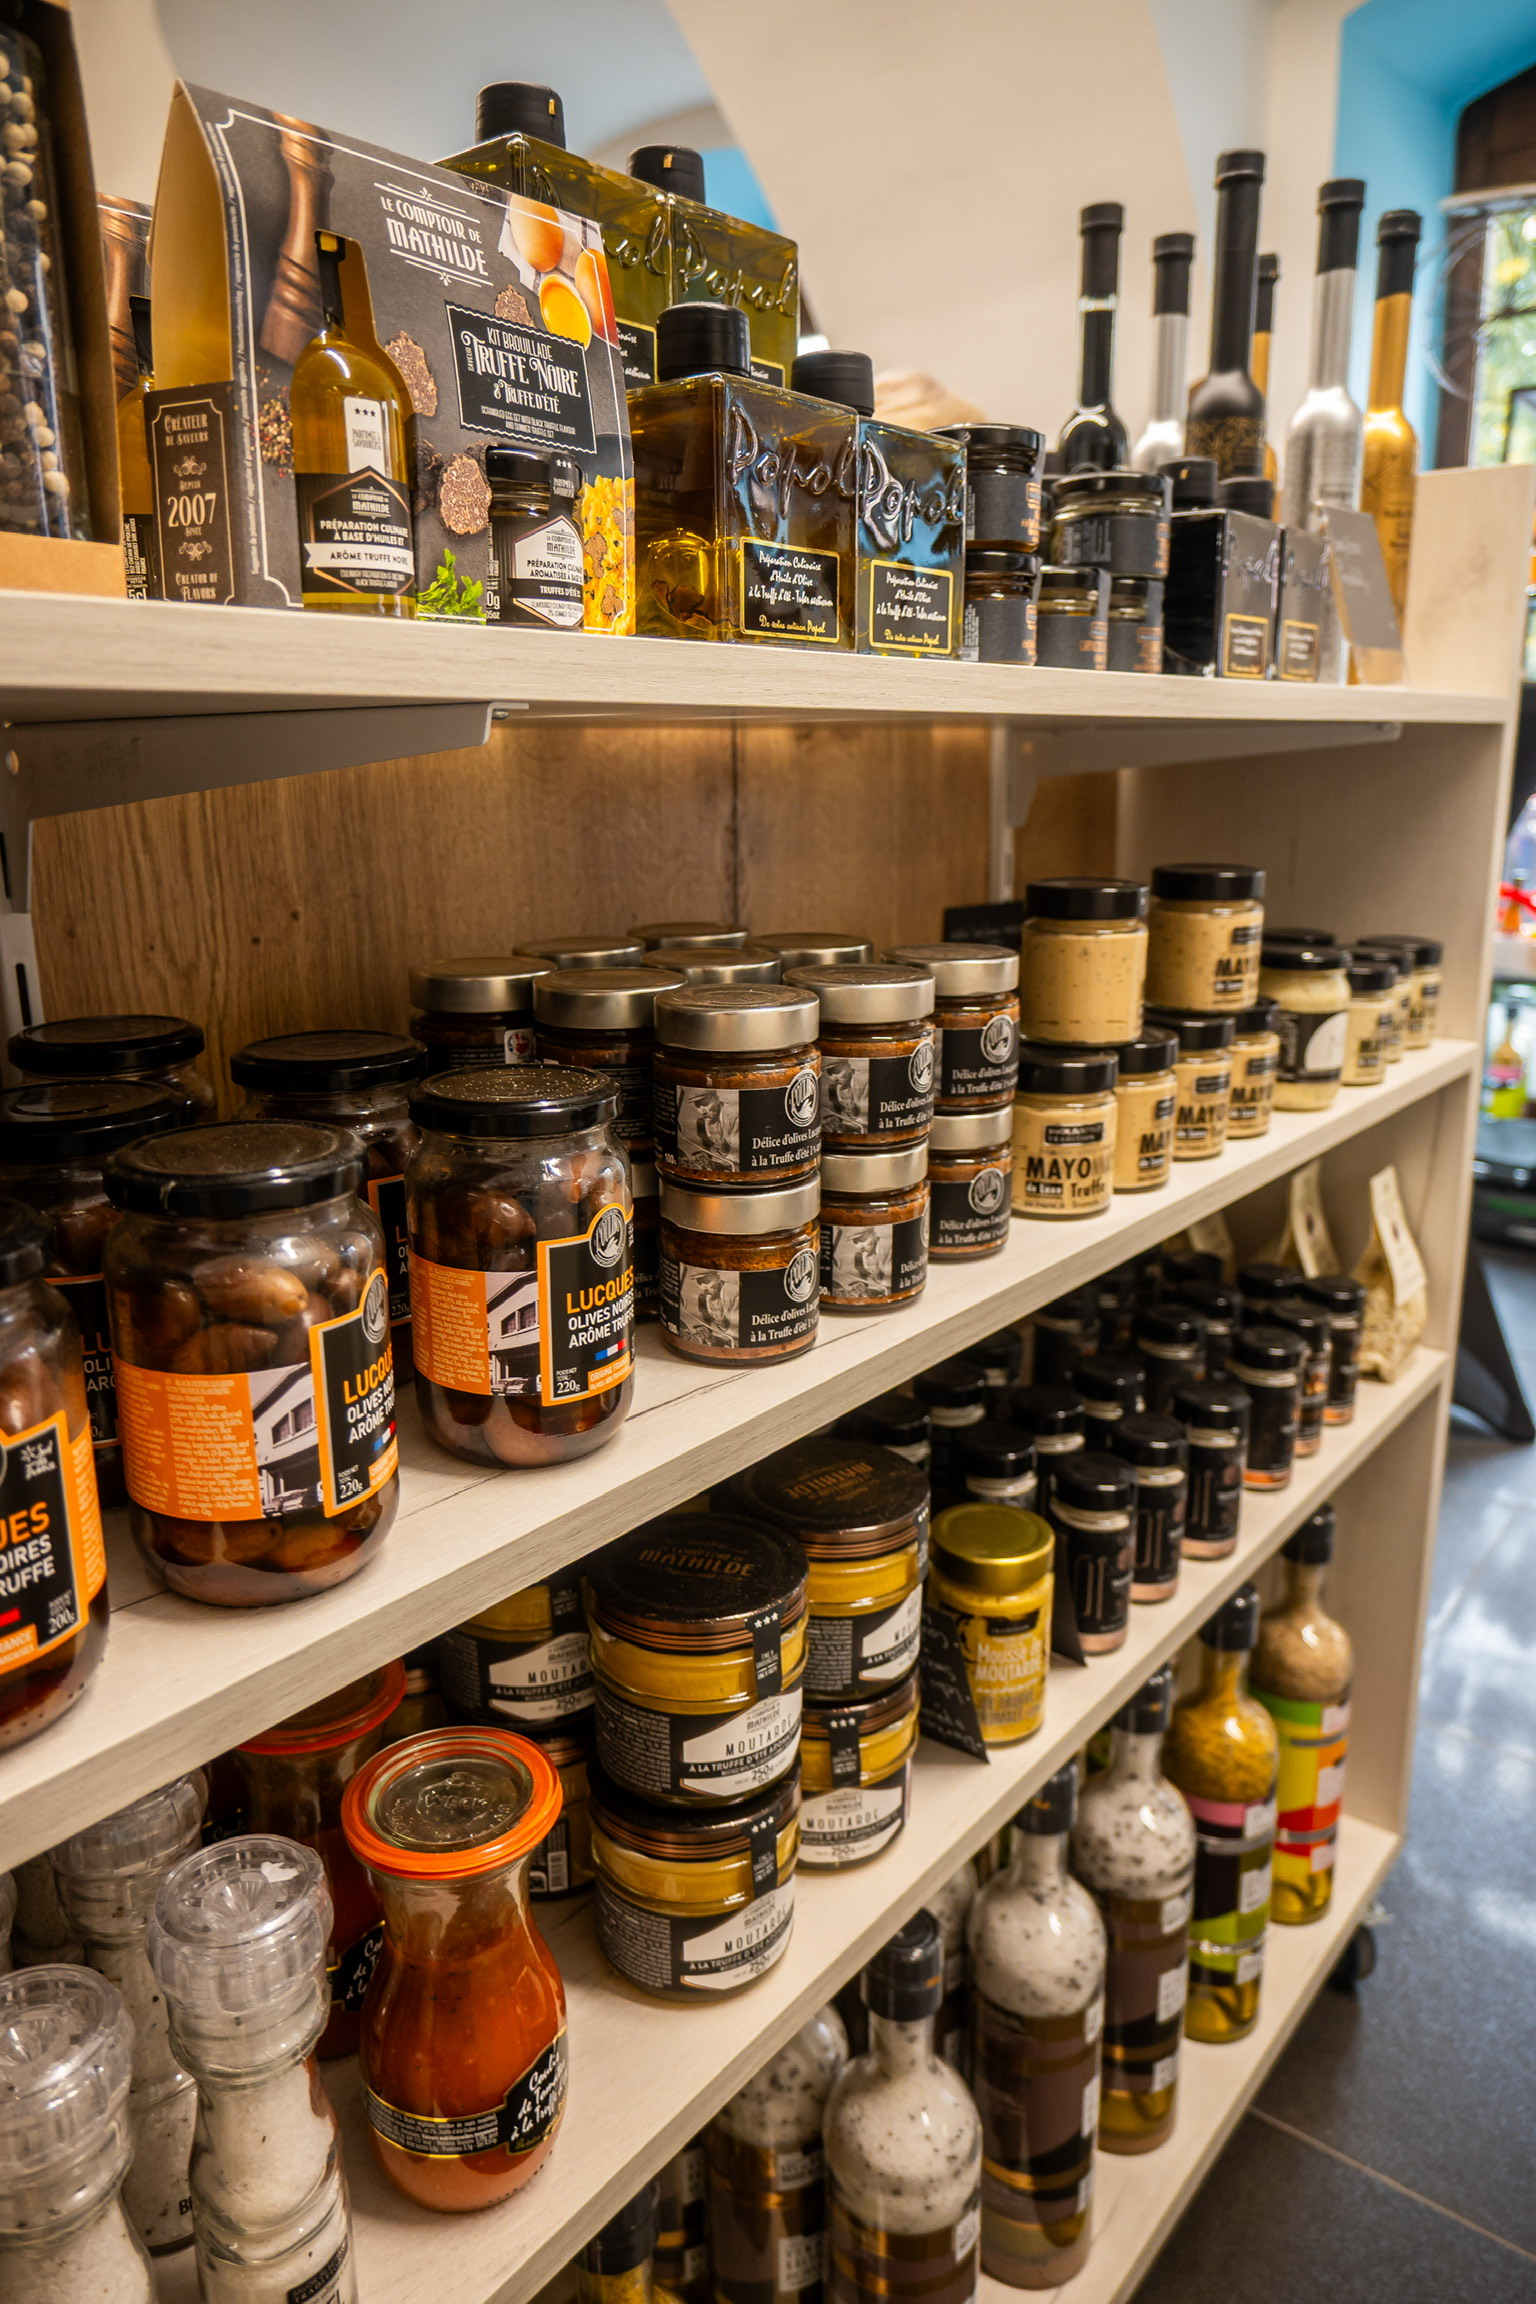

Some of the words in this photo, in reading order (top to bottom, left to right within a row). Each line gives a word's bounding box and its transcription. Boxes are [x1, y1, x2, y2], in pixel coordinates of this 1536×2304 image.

[380, 196, 394, 212] LE
[396, 200, 466, 240] COMPTOIR
[468, 228, 482, 244] DE
[386, 217, 489, 276] MATHILDE
[486, 326, 500, 346] KIT
[502, 332, 554, 362] BROUILLADE
[460, 330, 530, 384] TRUFFE
[528, 358, 581, 398] NOIRE
[466, 347, 474, 372] SAVEUR
[498, 379, 537, 408] TRUFFE
[536, 393, 561, 414] D'ÉTÉ
[164, 414, 208, 432] CRÉATEUR
[166, 436, 174, 446] DE
[177, 432, 208, 446] SAVEURS
[727, 405, 858, 519] Popol
[860, 435, 965, 543] Popol
[168, 492, 216, 528] 2007
[352, 501, 390, 514] MATHILDE
[320, 519, 379, 532] PRÉPARATION
[334, 530, 342, 541] À
[342, 532, 364, 542] BASE
[366, 534, 397, 545] D'HUILES
[330, 550, 361, 560] ARÔME
[364, 552, 391, 562] TRUFFE
[546, 542, 576, 556] MATHILDE
[527, 558, 567, 570] PRÉPARATION
[759, 550, 792, 567] Préparation
[793, 556, 822, 570] Culinaire
[176, 572, 208, 586] CREATOR
[209, 572, 218, 584] OF
[530, 569, 566, 580] AROMATISÉE
[770, 570, 792, 583] d'Huile
[792, 574, 812, 586] d'Olive
[540, 586, 565, 596] TRUFFES
[748, 586, 754, 597] à
[754, 584, 760, 598] la
[761, 584, 777, 605] Truffe
[759, 614, 770, 628] De
[807, 620, 826, 636] Popol
[924, 632, 940, 647] Popol
[880, 1101, 905, 1112] Délice
[879, 1118, 884, 1128] à
[886, 1118, 893, 1128] la
[894, 1114, 916, 1127] Truffe
[752, 1135, 780, 1150] Délice
[782, 1132, 808, 1146] d'olives
[752, 1156, 758, 1166] à
[759, 1154, 768, 1166] la
[769, 1150, 794, 1165] Truffe
[796, 1146, 809, 1160] d'été
[945, 1233, 952, 1244] la
[566, 1265, 634, 1314] LUCQUES
[568, 1307, 610, 1330] OLIVES
[752, 1314, 780, 1326] Délice
[781, 1308, 806, 1322] d'olives
[569, 1323, 611, 1348] ARÔME
[751, 1331, 756, 1342] à
[758, 1330, 766, 1341] la
[768, 1327, 792, 1340] Truffe
[794, 1320, 808, 1334] d'été
[556, 1379, 580, 1394] 220g
[347, 1387, 382, 1423] OLIVES
[348, 1407, 384, 1444] ARÔME
[340, 1478, 364, 1500] 220g
[640, 1550, 755, 1577] MATHILDE
[747, 1708, 780, 1730] MATHILDE
[726, 1713, 792, 1756] MOUTARDE
[712, 1758, 744, 1772] TRUFFE
[807, 1808, 878, 1830] MOUTARDE
[698, 1962, 708, 1970] LA
[518, 2098, 532, 2119] de
[511, 2125, 520, 2141] à
[522, 2116, 534, 2133] la
